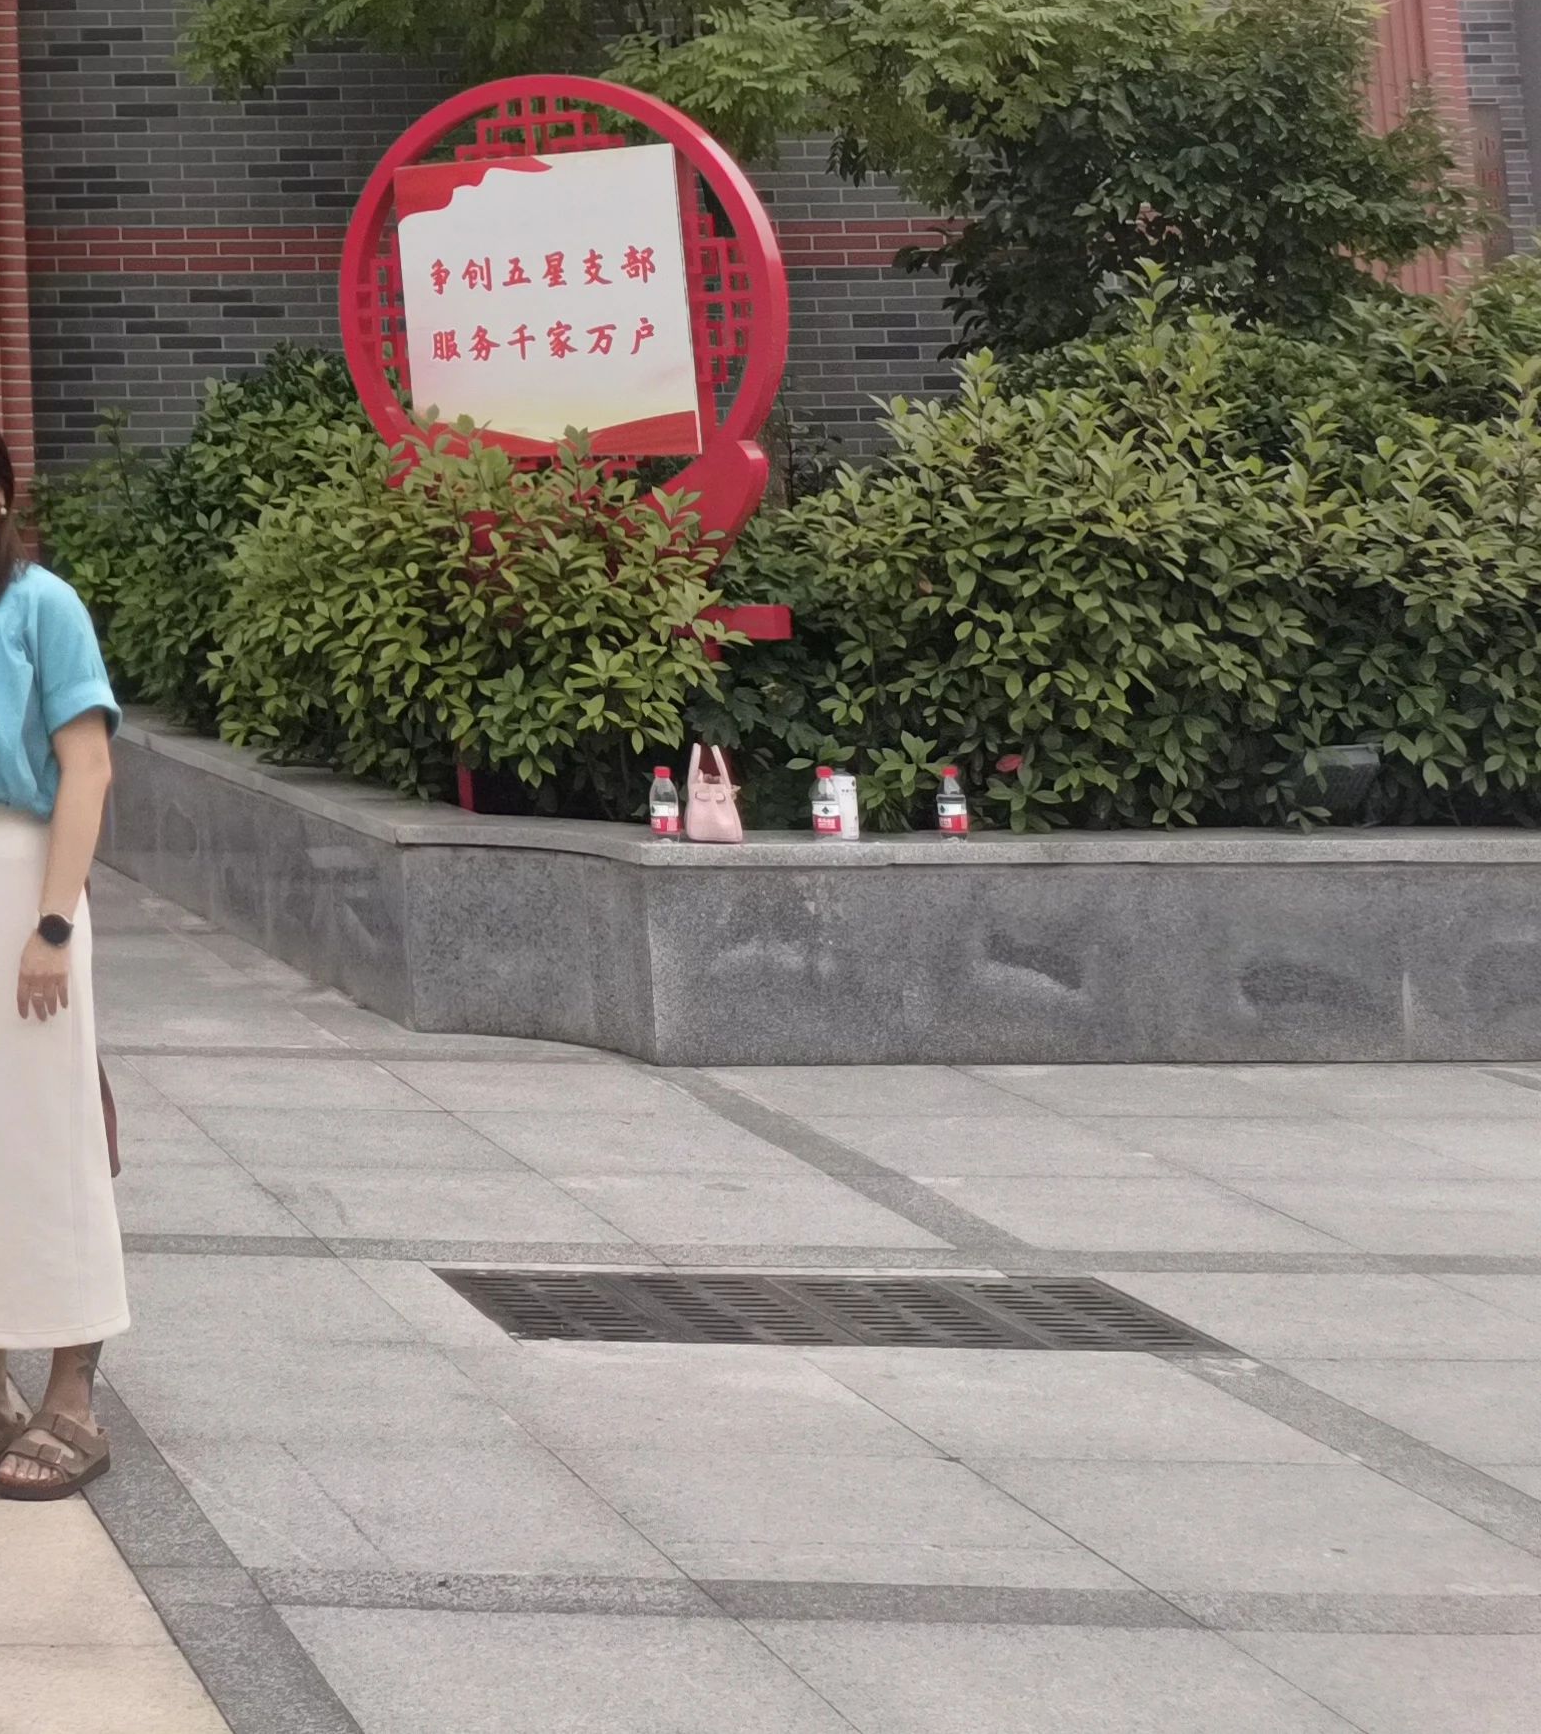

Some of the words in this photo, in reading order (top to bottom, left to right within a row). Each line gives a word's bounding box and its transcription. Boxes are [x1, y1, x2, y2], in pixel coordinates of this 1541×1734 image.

[429, 245, 657, 295] 争创五星支部
[431, 316, 656, 362] 服务千家万户
